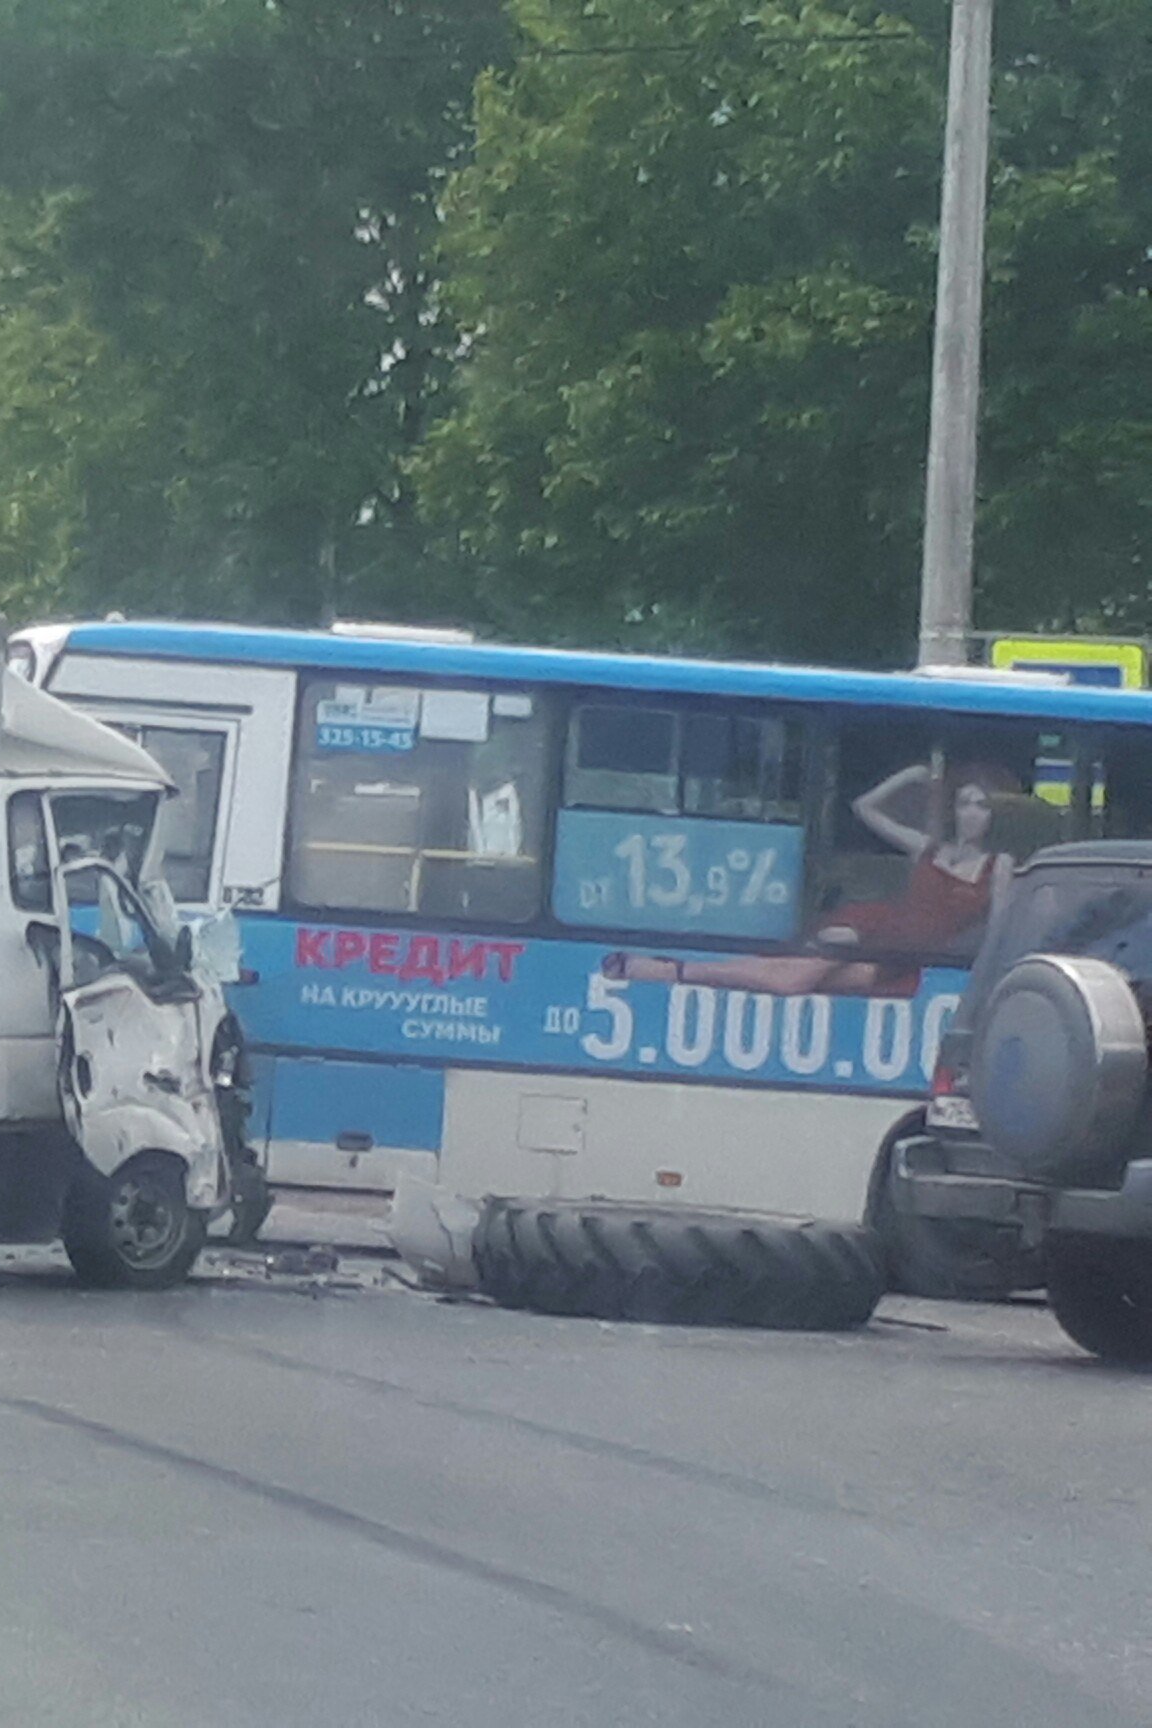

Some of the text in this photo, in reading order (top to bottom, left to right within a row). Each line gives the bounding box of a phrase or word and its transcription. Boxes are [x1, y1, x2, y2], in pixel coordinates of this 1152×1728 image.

[296, 928, 525, 988] КРЕДИТ
[301, 984, 488, 1016] НА КРУУУГЛЫЕ
[401, 1020, 501, 1044] СУММЫ
